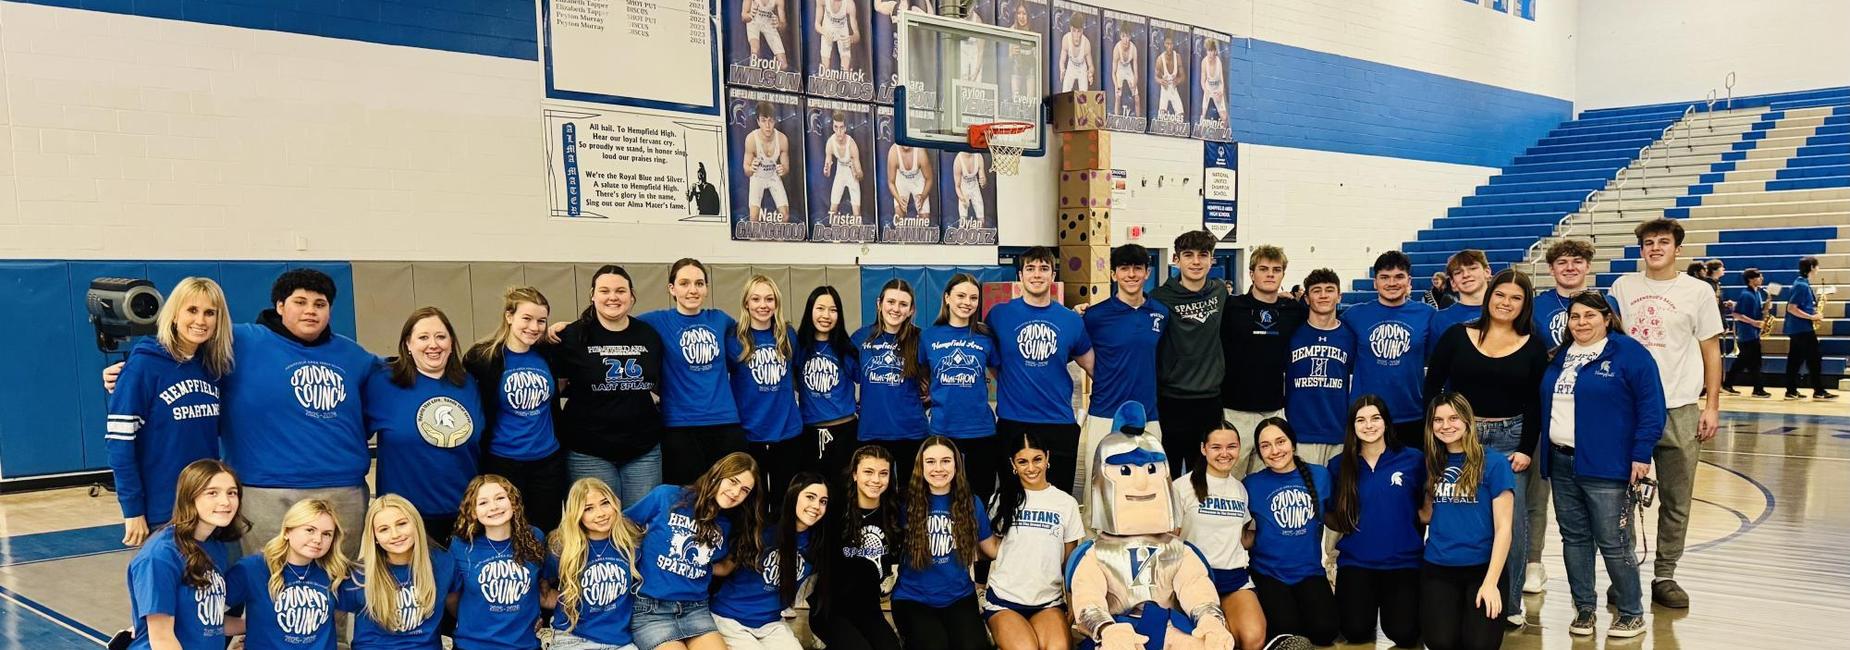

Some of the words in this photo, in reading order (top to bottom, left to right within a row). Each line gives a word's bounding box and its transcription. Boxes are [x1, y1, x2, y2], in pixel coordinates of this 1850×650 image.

[750, 54, 782, 73] Brody
[818, 64, 865, 82] Dominick
[730, 64, 800, 93] WILSON
[808, 75, 873, 101] WOODS
[961, 85, 986, 100] aylon
[589, 123, 599, 132] All
[627, 127, 659, 136] Hempfield
[660, 129, 677, 138] High.
[593, 132, 608, 141] Hear
[623, 135, 638, 144] loyal
[578, 141, 587, 149] So
[589, 143, 614, 152] proudly
[602, 152, 617, 160] loud
[631, 155, 652, 163] praises
[654, 157, 668, 165] ring.
[585, 171, 605, 179] We're
[619, 173, 637, 182] Royal
[666, 175, 685, 183] Silver.
[593, 180, 599, 188] A
[630, 183, 661, 193] Hempfield
[663, 185, 680, 193] High.
[585, 199, 600, 208] Sing
[627, 201, 644, 209] Alma
[645, 201, 669, 209] Mater's
[595, 189, 619, 197] There's
[621, 191, 637, 200] glory
[758, 208, 784, 222] Nate
[828, 211, 862, 225] Tristan
[892, 214, 930, 228] Carmine
[959, 216, 983, 230] Dylan
[679, 327, 717, 347] STUDENT
[1017, 323, 1057, 344] STUDENT
[1369, 323, 1411, 342] STUDENT
[682, 341, 720, 365] COUNCIL
[1018, 339, 1058, 361] COUNCIL
[1292, 345, 1348, 364] HEMPFIELD
[1370, 338, 1411, 360] COUNCIL
[290, 365, 344, 389] STUDENT
[504, 370, 549, 393] STUDENT
[751, 362, 787, 385] COUNCIL
[804, 371, 840, 393] COUNCIL
[1294, 377, 1343, 389] WRESTLING
[159, 379, 221, 406] HEMPFIELD
[294, 383, 347, 411] COUNCIL
[591, 382, 618, 391] LAST
[507, 385, 550, 410] COUNCIL
[1271, 488, 1313, 512] STUDENT
[1274, 503, 1316, 529] COUNCIL
[478, 559, 531, 584] STUDENT
[581, 561, 627, 588] STUDENT
[274, 585, 328, 613] STUDENT
[480, 577, 531, 605] COUNCIL
[583, 577, 629, 606] COUNCIL
[277, 604, 329, 635] COUNCIL
